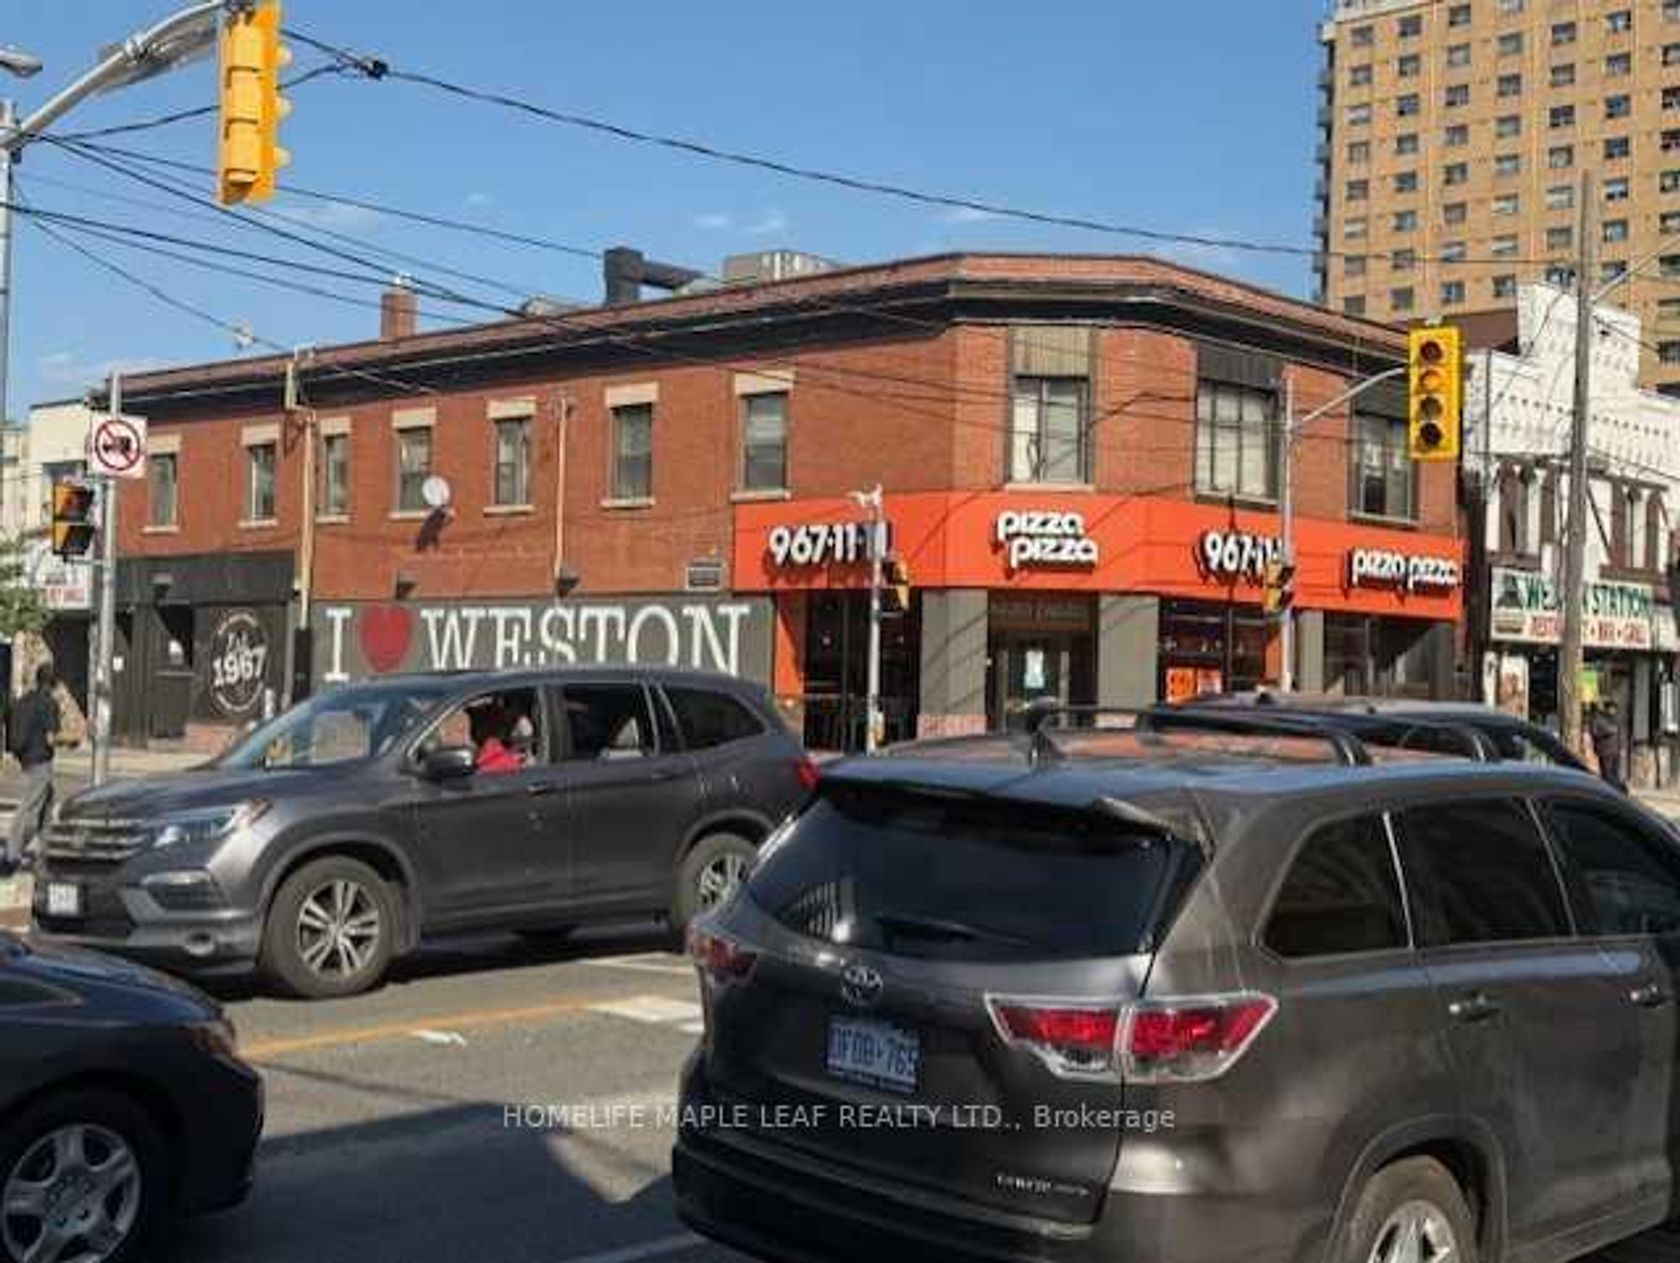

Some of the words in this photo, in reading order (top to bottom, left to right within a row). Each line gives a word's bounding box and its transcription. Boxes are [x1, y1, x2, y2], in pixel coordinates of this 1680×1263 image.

[997, 511, 1085, 541] pizza
[1010, 537, 1099, 568] pizza
[1352, 550, 1405, 583] pizza
[1591, 584, 1650, 619] STATION
[324, 608, 352, 682] I
[420, 604, 750, 677] WESTON
[212, 645, 267, 687] 1967
